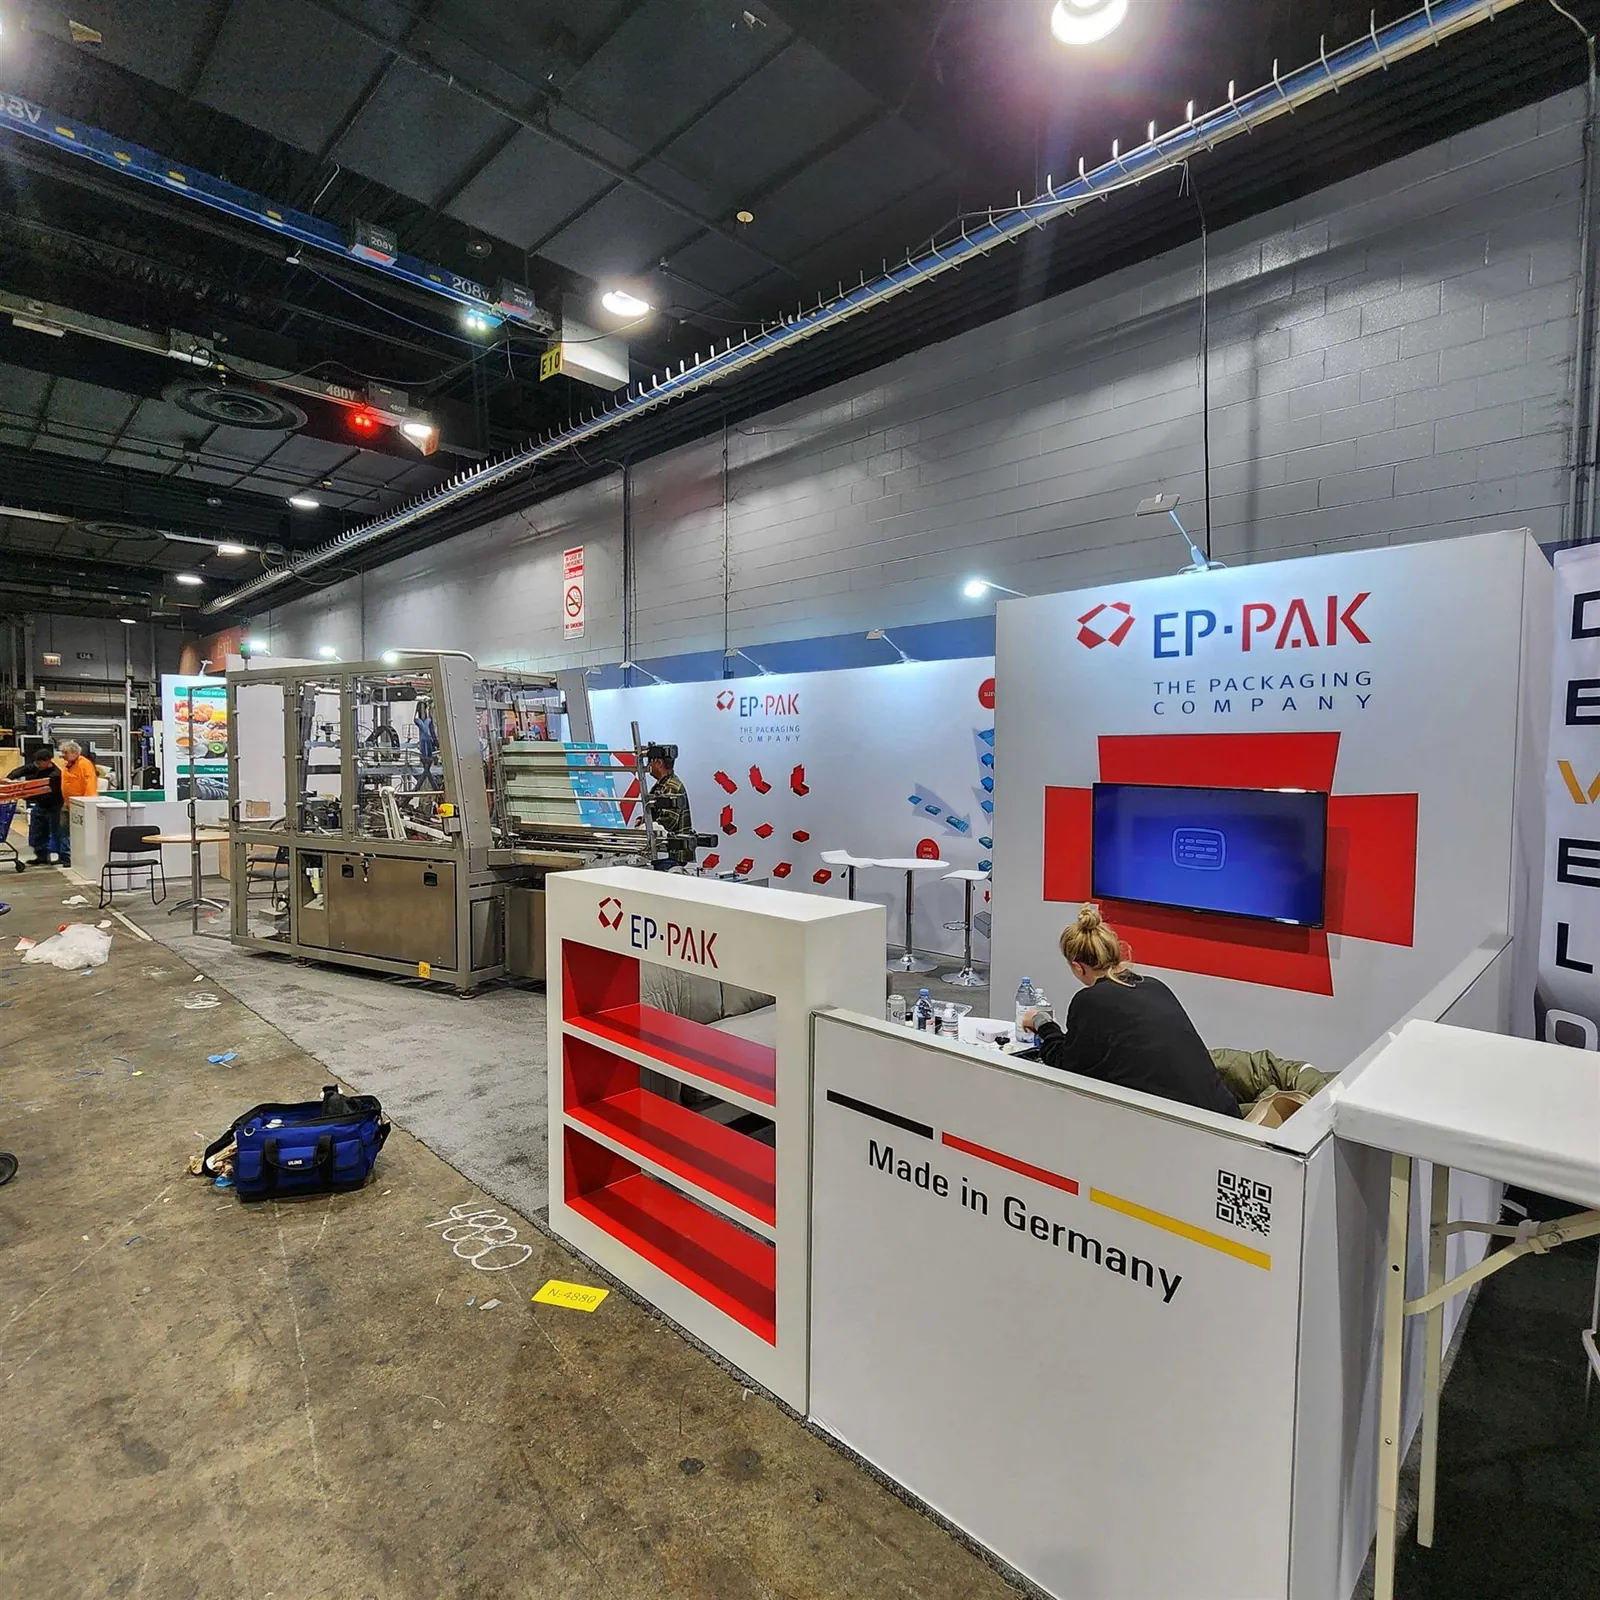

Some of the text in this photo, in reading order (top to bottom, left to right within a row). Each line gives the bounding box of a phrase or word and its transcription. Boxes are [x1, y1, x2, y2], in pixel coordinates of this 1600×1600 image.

[542, 351, 560, 376] E10
[326, 384, 355, 401] 480V
[1154, 670, 1372, 696] THE PACKAGING
[1153, 693, 1372, 716] COMPANY
[739, 735, 801, 743] COMPANY
[755, 724, 800, 733] PACKAGING
[868, 1139, 1183, 1304] Made in Germany
